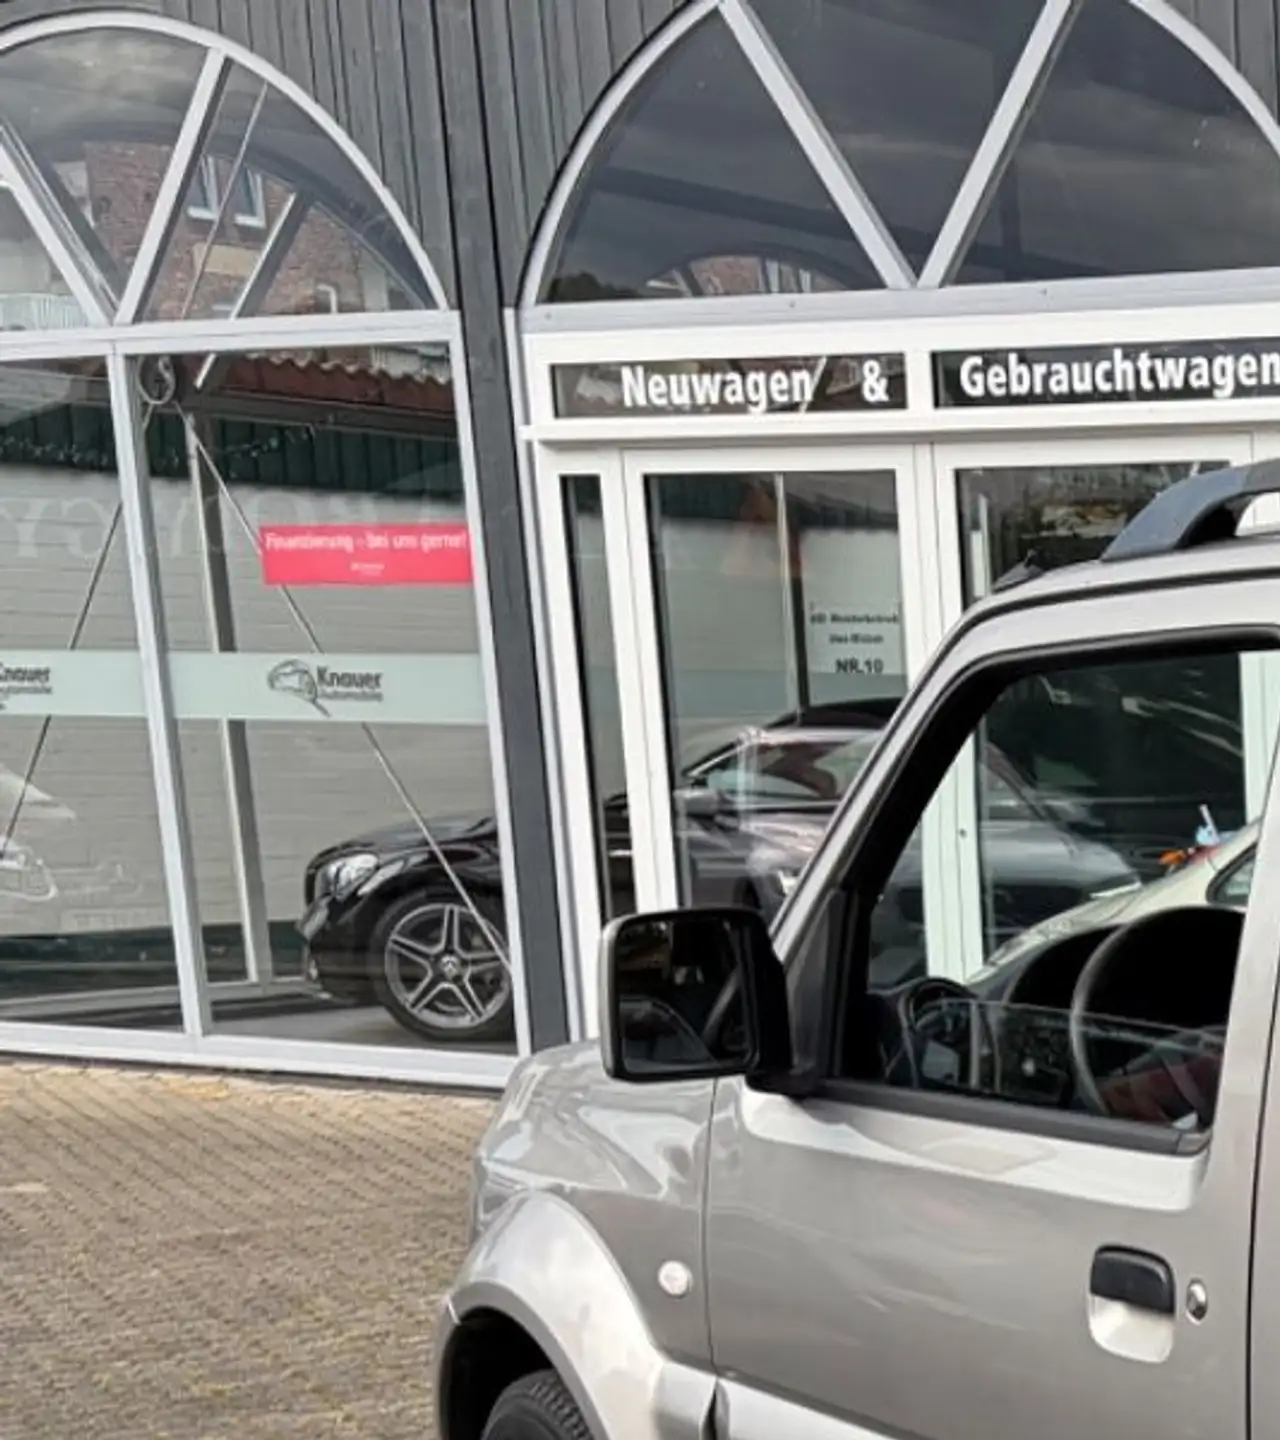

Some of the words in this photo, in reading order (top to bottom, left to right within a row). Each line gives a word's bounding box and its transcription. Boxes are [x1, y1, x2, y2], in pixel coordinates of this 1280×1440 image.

[619, 364, 814, 413] Neuwagen
[862, 359, 890, 402] &
[316, 665, 382, 689] Knauer
